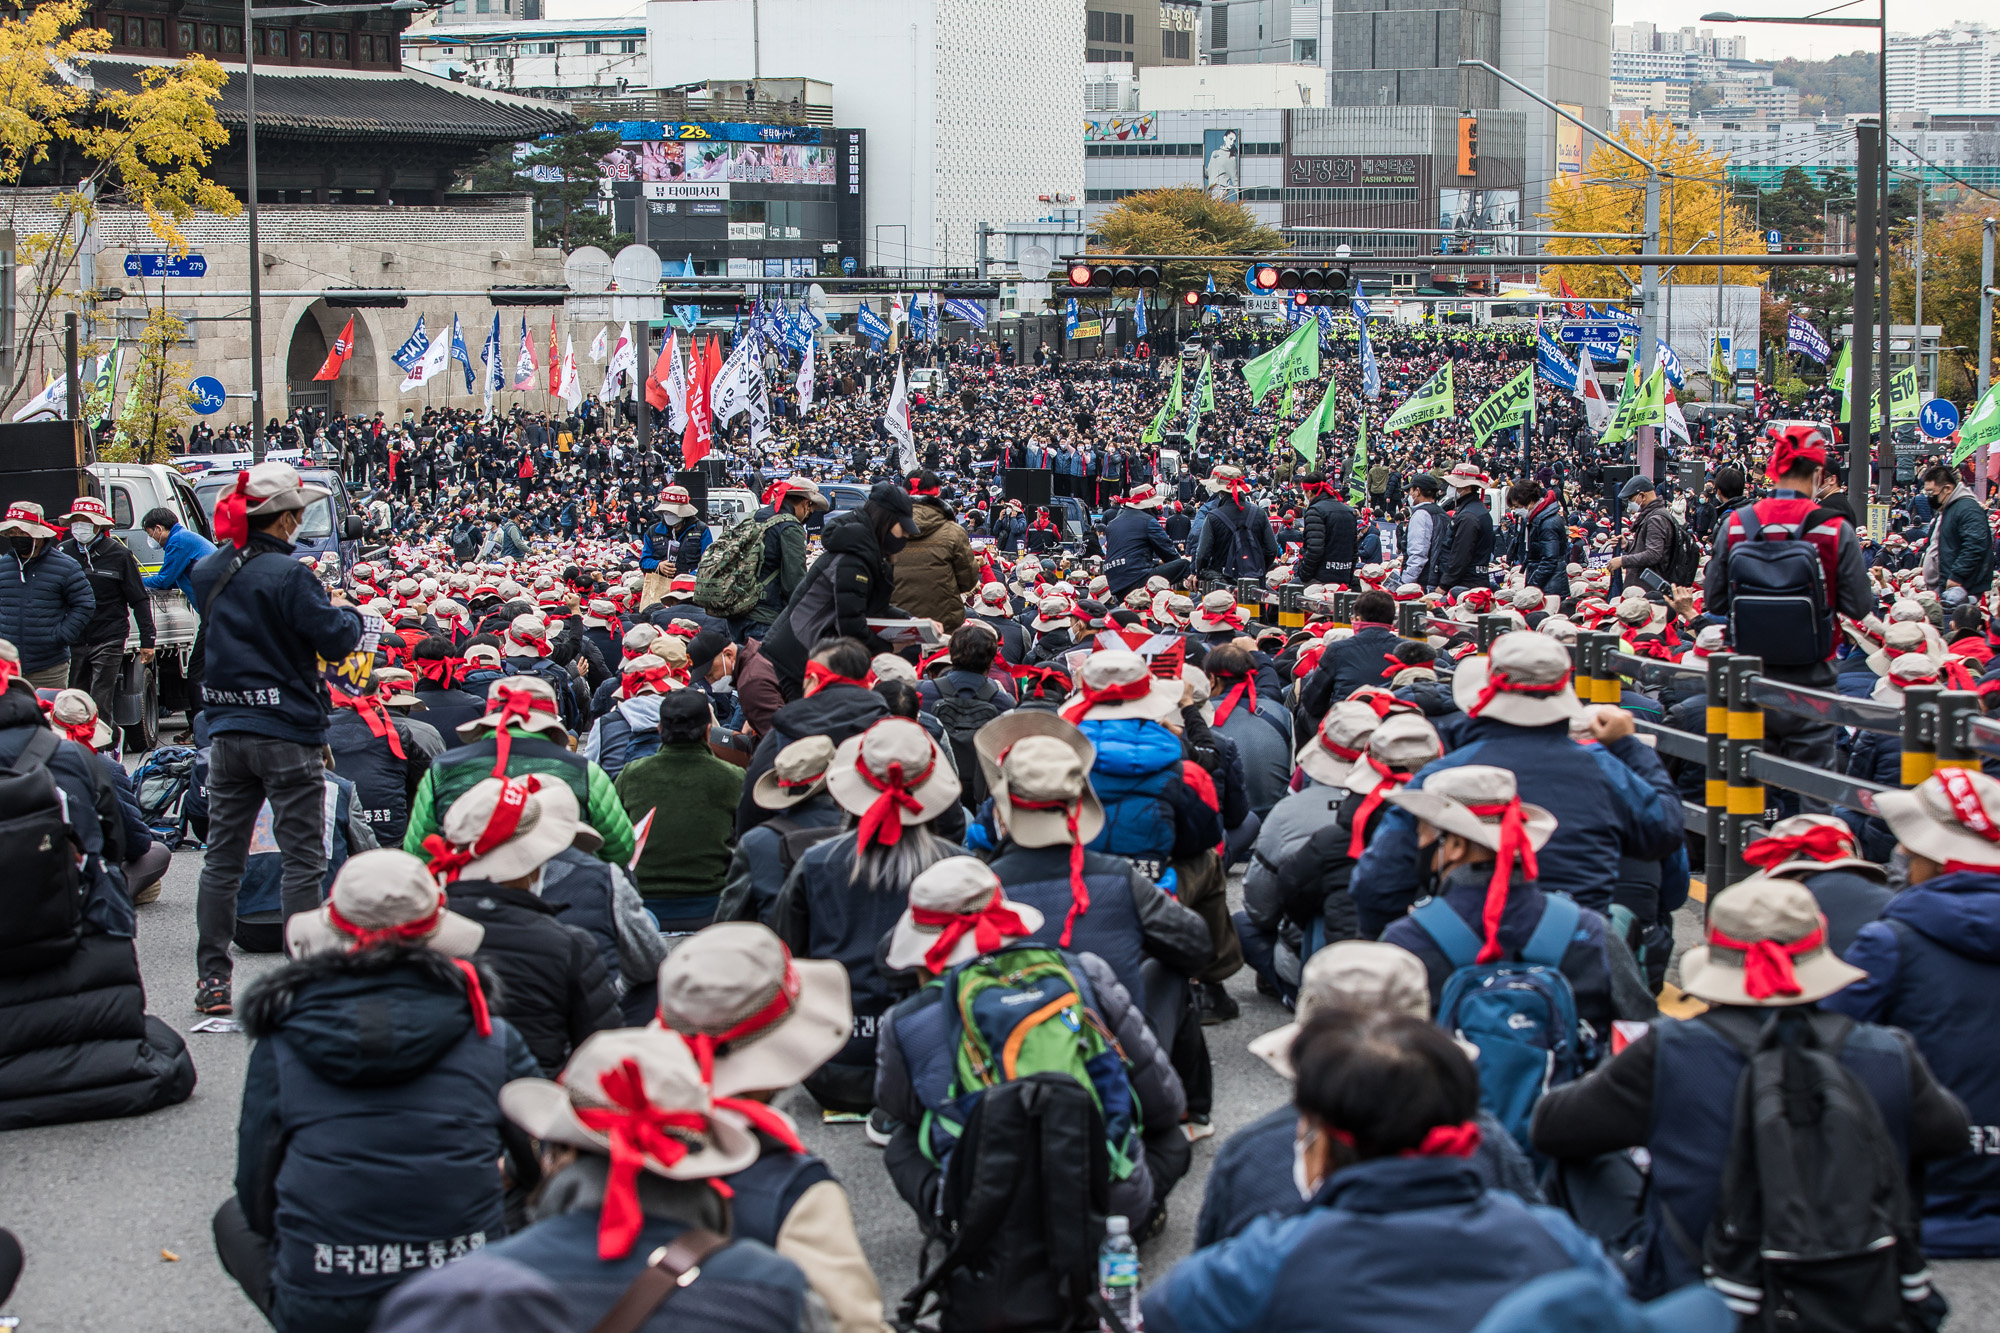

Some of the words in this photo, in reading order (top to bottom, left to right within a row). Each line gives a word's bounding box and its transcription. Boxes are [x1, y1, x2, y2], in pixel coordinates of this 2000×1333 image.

[1291, 159, 1355, 183] 신평화
[1361, 158, 1415, 175] 패션타운
[656, 186, 664, 198] 뷰
[669, 186, 719, 198] 타이마사지
[155, 256, 176, 268] 종로
[189, 262, 204, 270] 279
[151, 268, 180, 277] Jong-ro
[1248, 300, 1278, 310] 동시신호
[1583, 328, 1598, 336] 종로
[201, 685, 281, 706] 전국건설노동조합
[314, 1232, 486, 1275] 전국건설노동조합
